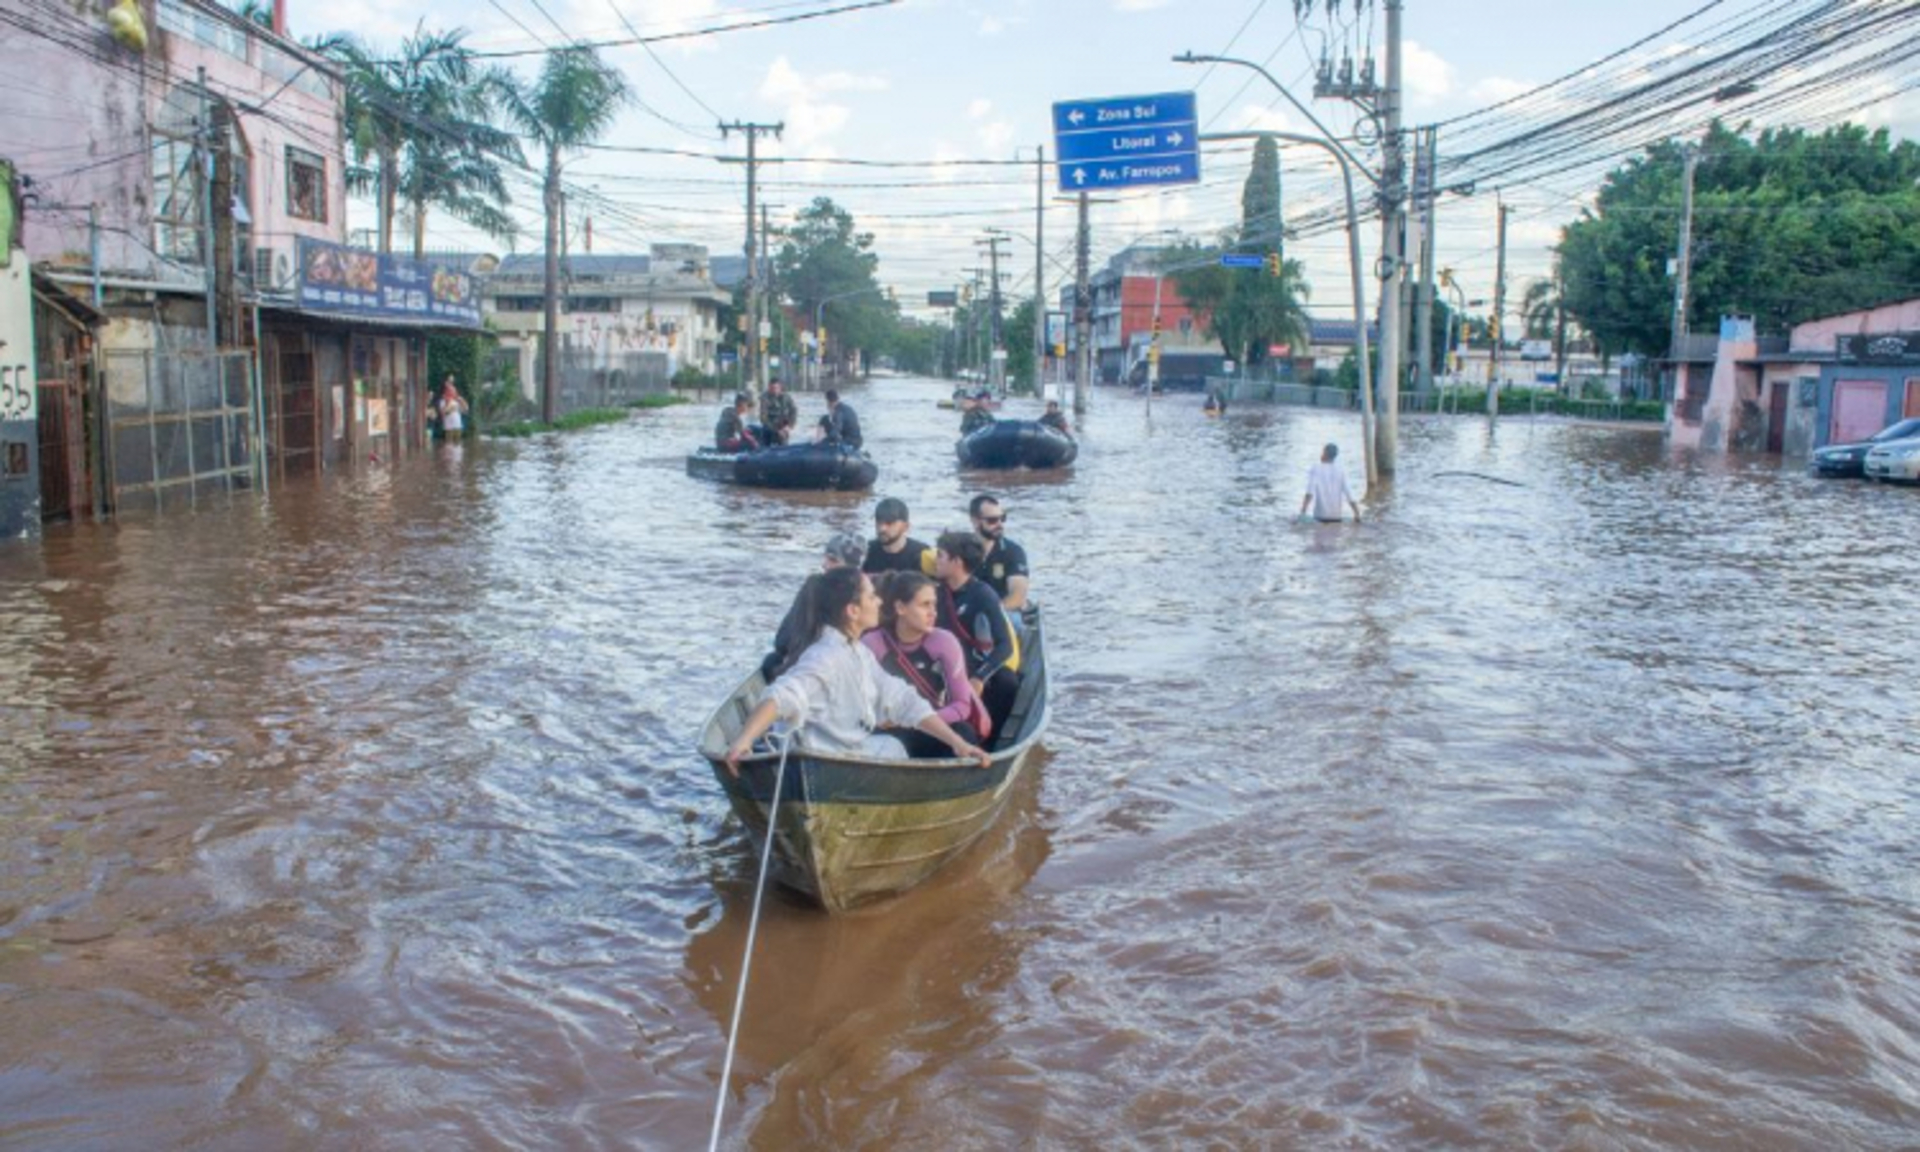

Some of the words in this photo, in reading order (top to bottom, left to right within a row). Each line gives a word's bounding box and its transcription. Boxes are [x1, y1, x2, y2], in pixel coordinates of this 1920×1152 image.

[1096, 108, 1131, 122] Zona
[1133, 105, 1156, 119] Sul
[1112, 134, 1156, 150] Litoral
[1098, 168, 1119, 181] Av.
